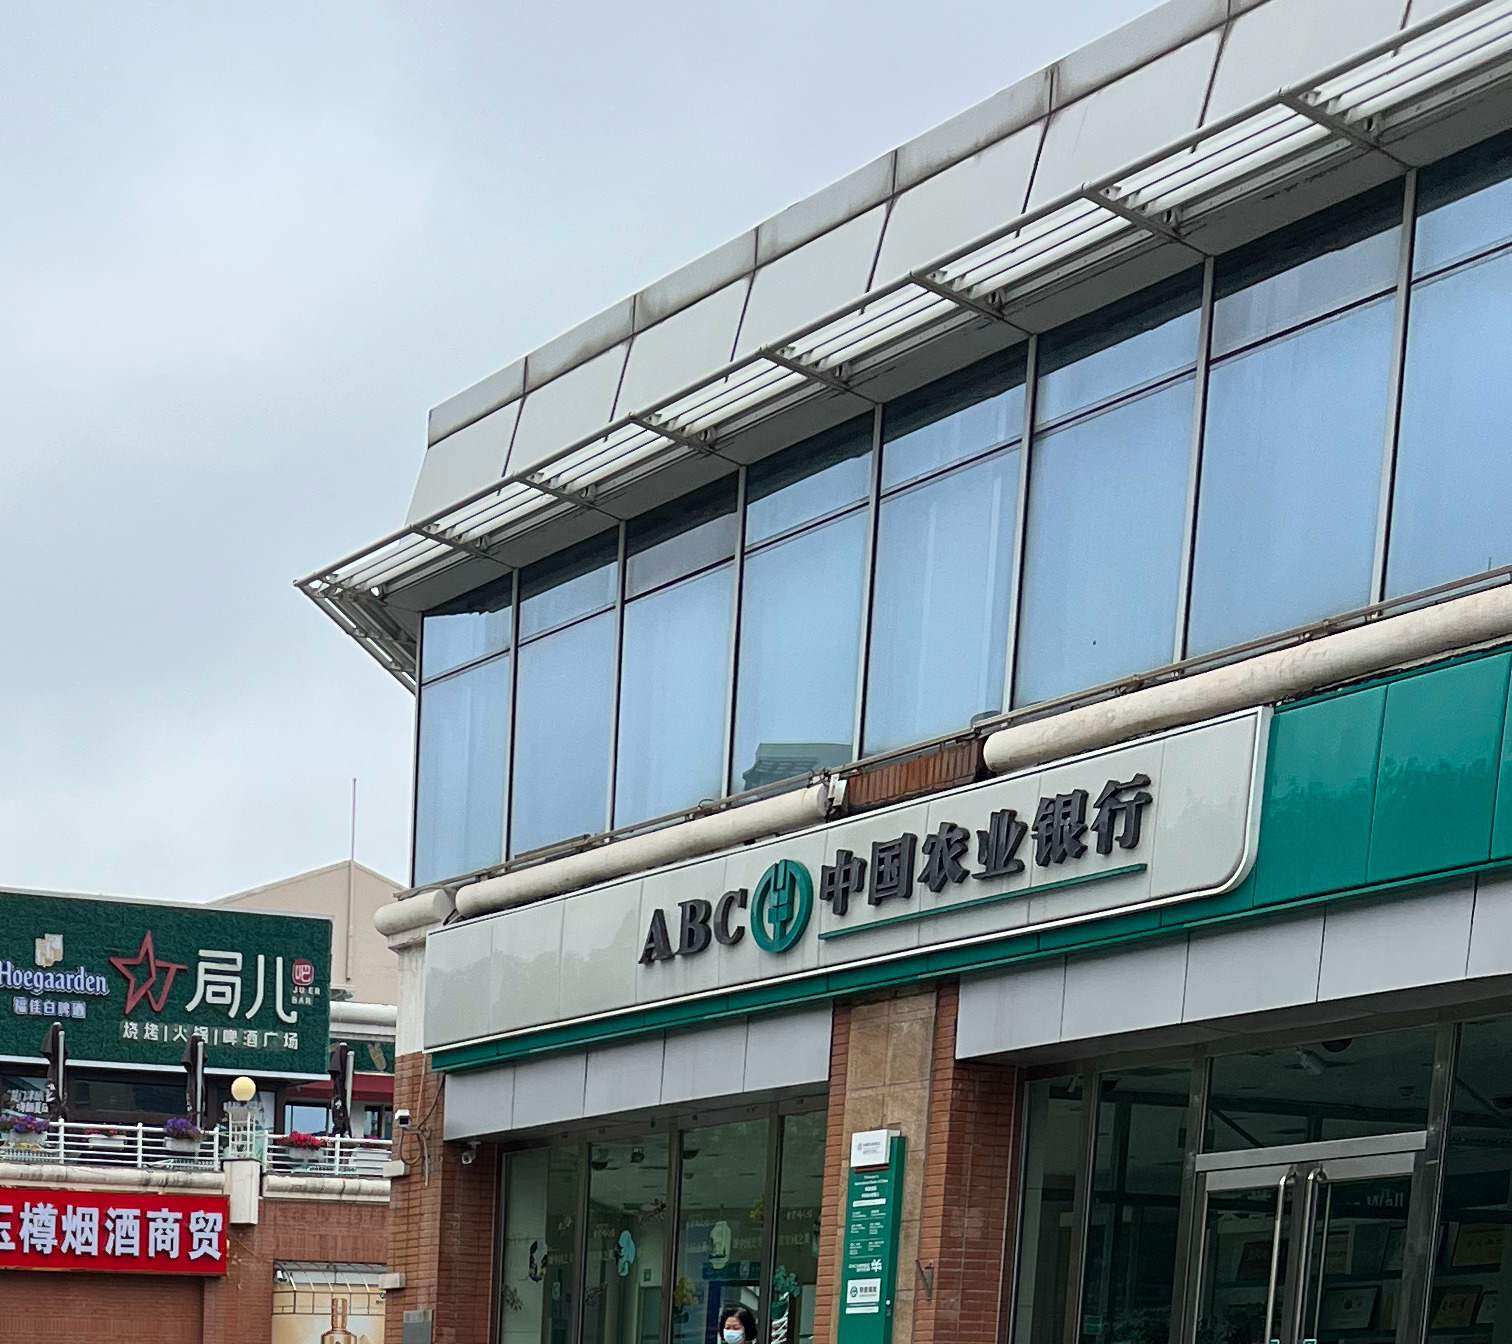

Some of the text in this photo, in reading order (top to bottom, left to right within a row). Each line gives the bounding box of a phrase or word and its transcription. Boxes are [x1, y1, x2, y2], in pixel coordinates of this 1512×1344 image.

[819, 773, 1152, 916] 中国农业银行
[638, 888, 748, 964] ABC
[185, 949, 297, 1024] 局儿
